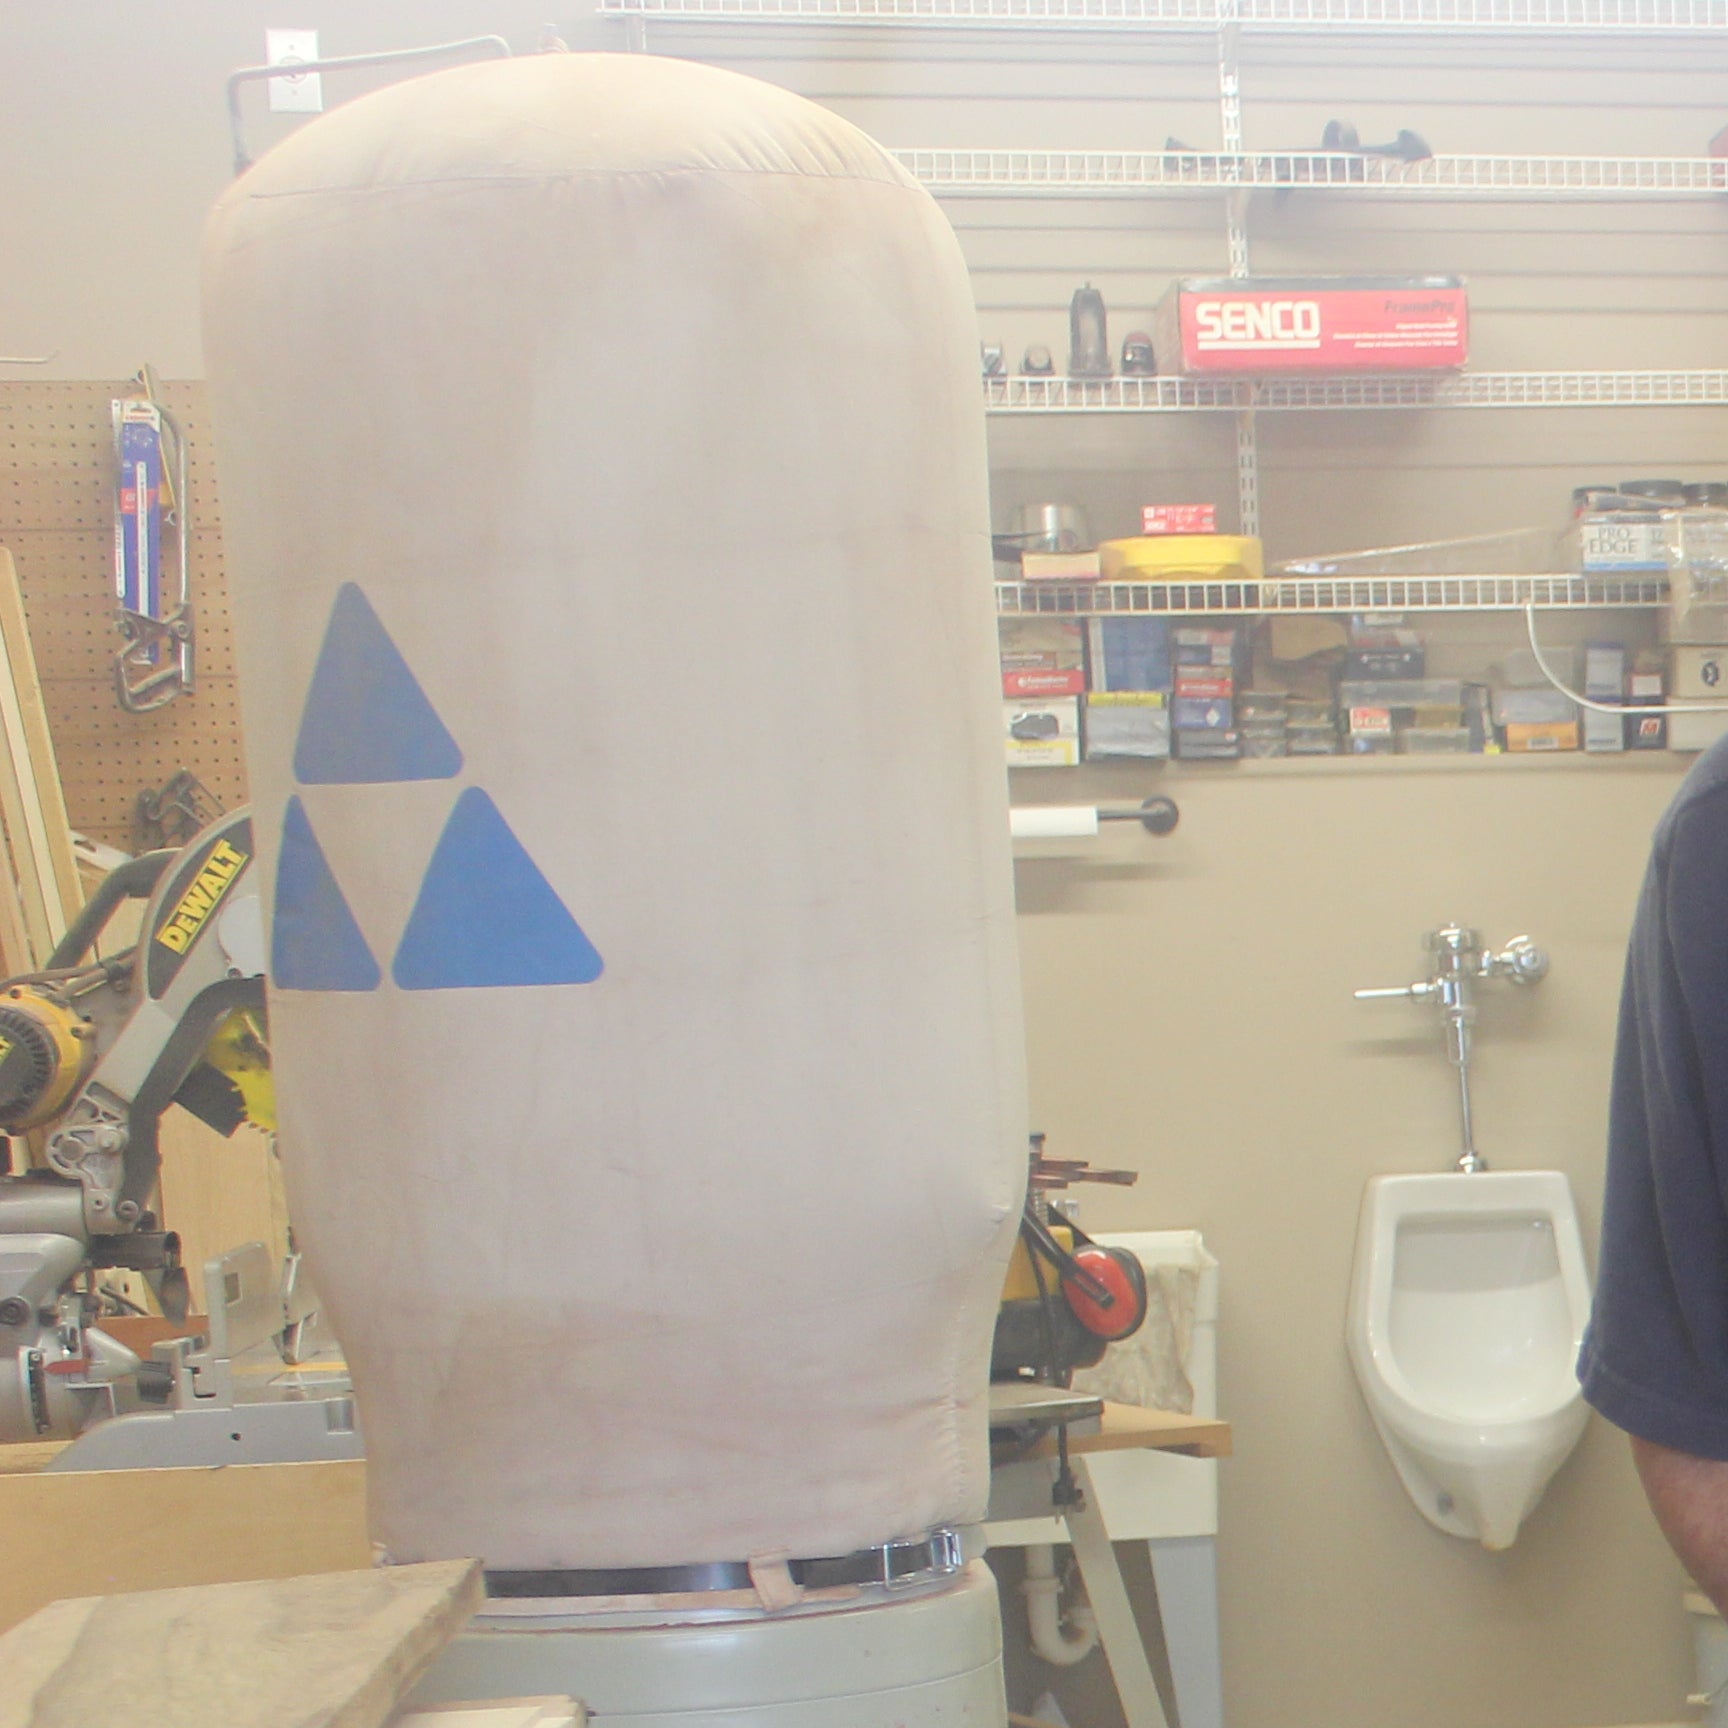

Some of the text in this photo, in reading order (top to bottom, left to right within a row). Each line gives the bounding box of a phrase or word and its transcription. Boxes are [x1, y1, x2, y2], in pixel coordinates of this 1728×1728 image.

[1196, 301, 1320, 339] SENCO
[1598, 527, 1631, 539] PRO
[1589, 540, 1637, 554] EDGE
[158, 838, 249, 955] DEWALT
